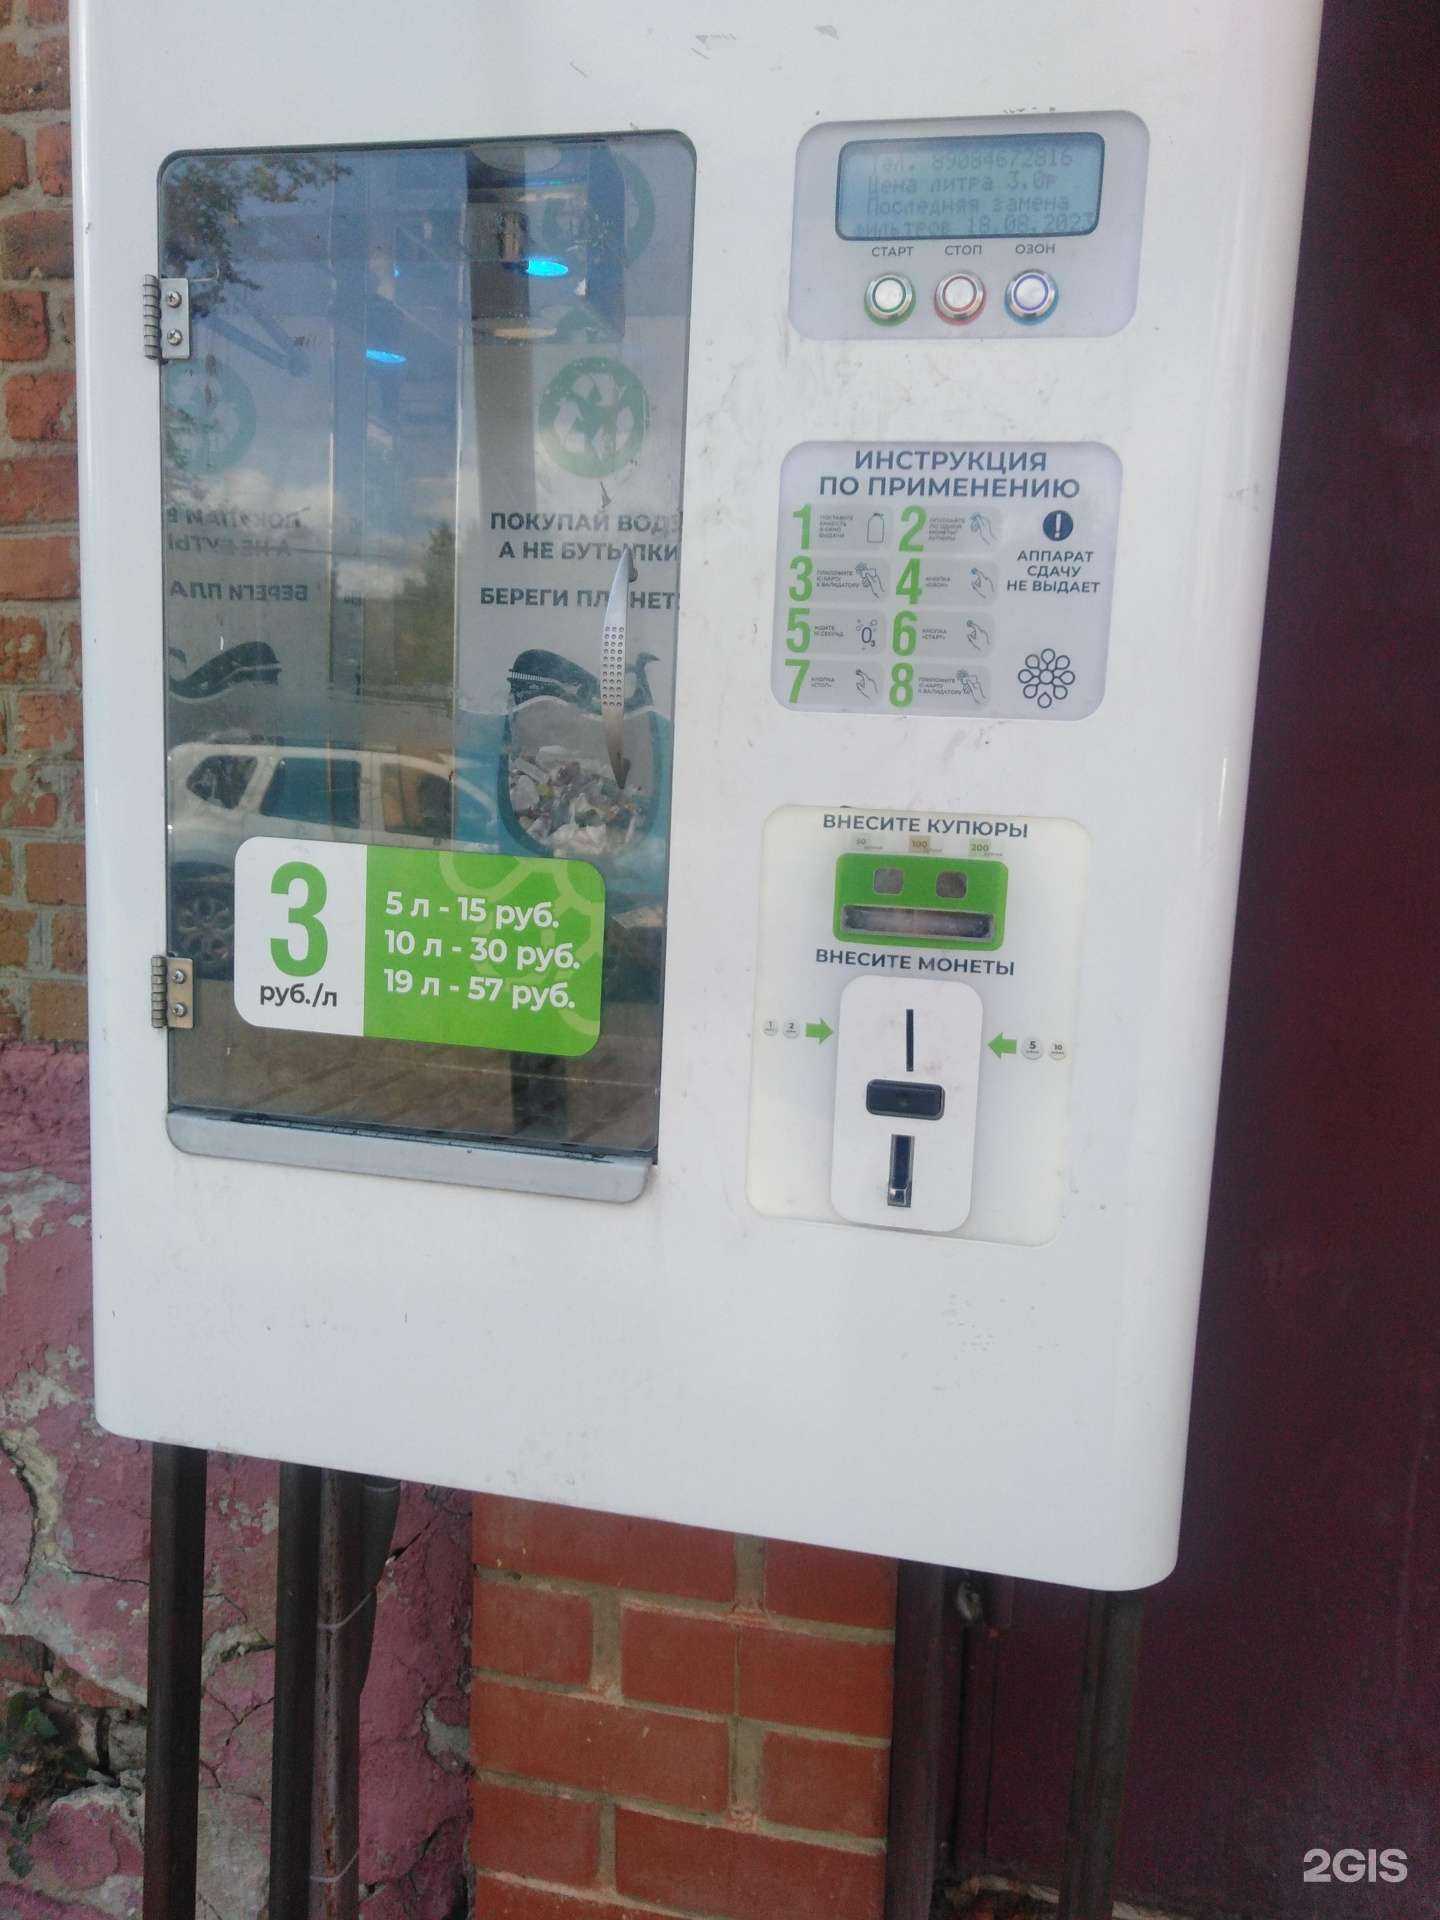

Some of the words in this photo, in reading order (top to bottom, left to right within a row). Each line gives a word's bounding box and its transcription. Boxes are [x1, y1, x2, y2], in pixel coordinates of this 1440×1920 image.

[871, 246, 915, 257] СТАРТ
[944, 244, 983, 256] СТОП
[1015, 243, 1056, 255] ОЗОН
[854, 450, 1047, 474] ИНСТРУКЦИЯ
[819, 476, 859, 496] ПО
[868, 477, 1080, 498] ПРИМЕНЕНИЮ
[490, 511, 609, 531] ПОКУПАЙ
[793, 503, 811, 550] 1
[899, 505, 927, 552] 2
[499, 541, 516, 559] А
[523, 541, 554, 559] НЕ
[1017, 549, 1094, 562] АППАРАТ
[789, 555, 813, 602] 3
[895, 558, 922, 605] 4
[1027, 564, 1081, 578] СДАЧУ
[480, 587, 568, 607] БЕРЕГИ
[1006, 580, 1027, 592] НЕ
[1032, 580, 1101, 594] ВЫДАЕТ
[786, 607, 811, 654] 5
[892, 610, 918, 657] 6
[784, 658, 811, 704] 7
[889, 662, 914, 708] 8
[823, 814, 921, 833] ВНЕСИТЕ
[927, 818, 1028, 838] КУПЮРЫ
[911, 839, 928, 849] 100
[270, 861, 328, 977] 3
[385, 891, 403, 916] 5
[409, 898, 430, 918] л
[458, 897, 487, 923] 15
[495, 902, 560, 932] руб.
[384, 930, 415, 955] 10
[422, 937, 443, 957] л
[470, 937, 508, 963] 30
[516, 943, 581, 971] руб.
[815, 948, 911, 970] ВНЕСИТЕ
[918, 956, 1015, 976] МОНЕТЫ
[259, 982, 338, 1008] руб./л
[384, 968, 413, 993] 19
[420, 975, 441, 997] л
[467, 976, 504, 1002] 57
[511, 982, 576, 1011] руб.
